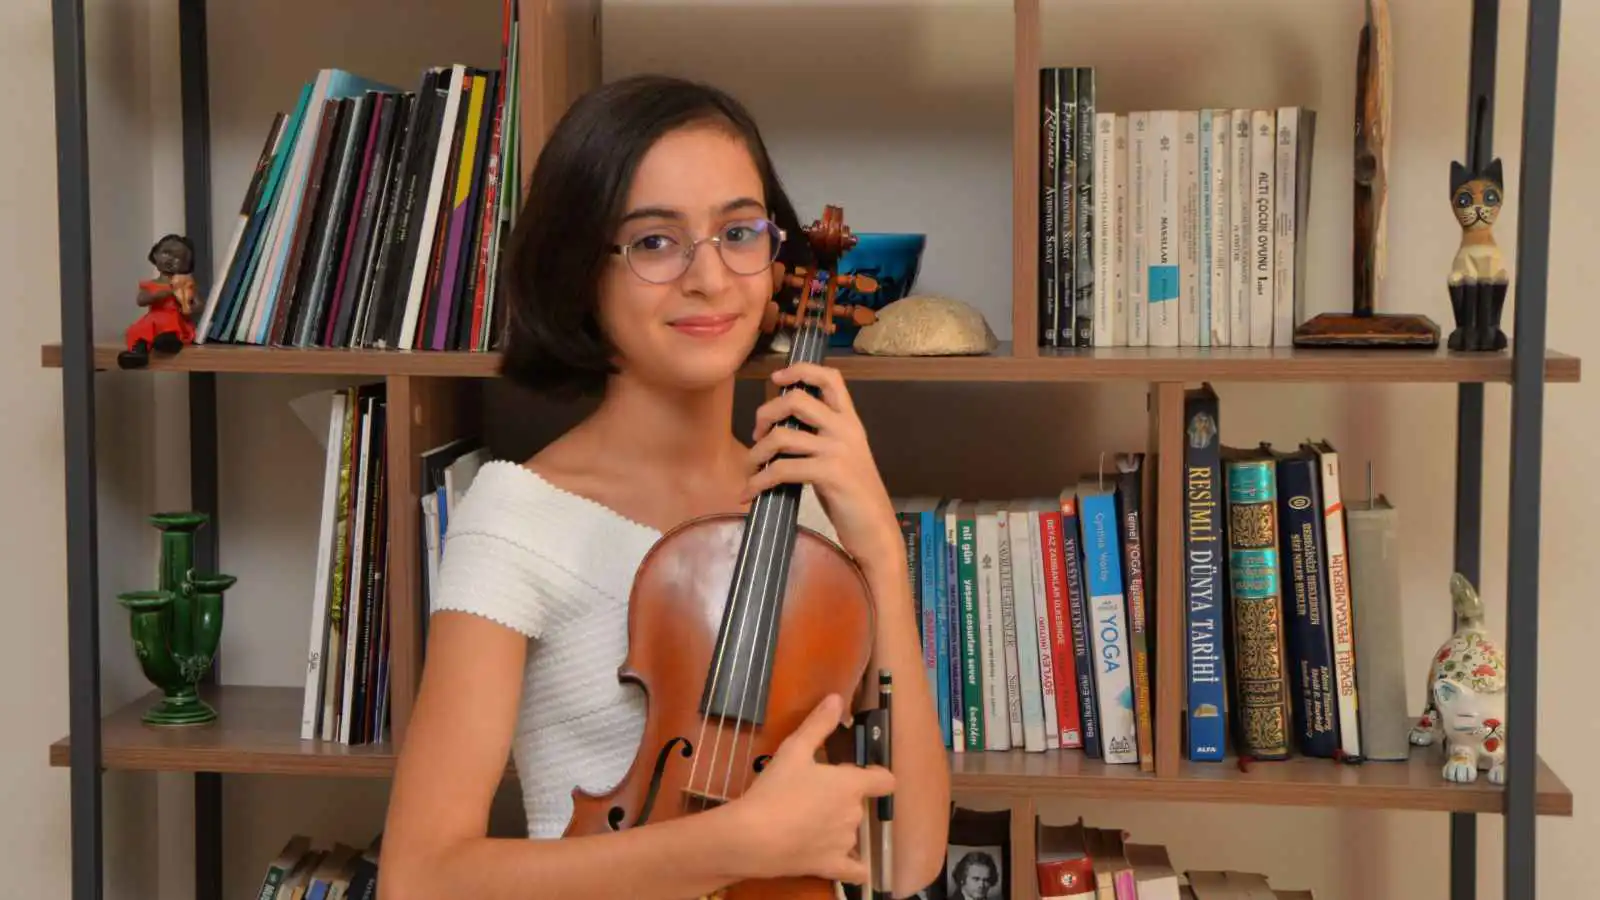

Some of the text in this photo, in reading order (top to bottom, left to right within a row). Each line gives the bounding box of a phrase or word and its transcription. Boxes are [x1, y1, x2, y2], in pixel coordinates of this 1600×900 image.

[1258, 172, 1269, 195] ALTI
[1256, 198, 1269, 233] ÇOCUK
[1046, 235, 1055, 264] SANAT
[1063, 231, 1072, 259] SANAT
[1080, 231, 1091, 260] SANAT
[1258, 235, 1268, 271] OYUNU
[1092, 512, 1106, 549] Cynthia
[1128, 511, 1140, 540] Temel
[961, 526, 974, 565] nil gün
[1065, 538, 1079, 587] YAŞAMAK
[1130, 543, 1141, 576] YOGA
[1188, 466, 1220, 684] RESİMLİ DÜNYA TARİHİ
[1330, 553, 1350, 644] PEYGAMBERİM
[1100, 615, 1121, 674] YOGA
